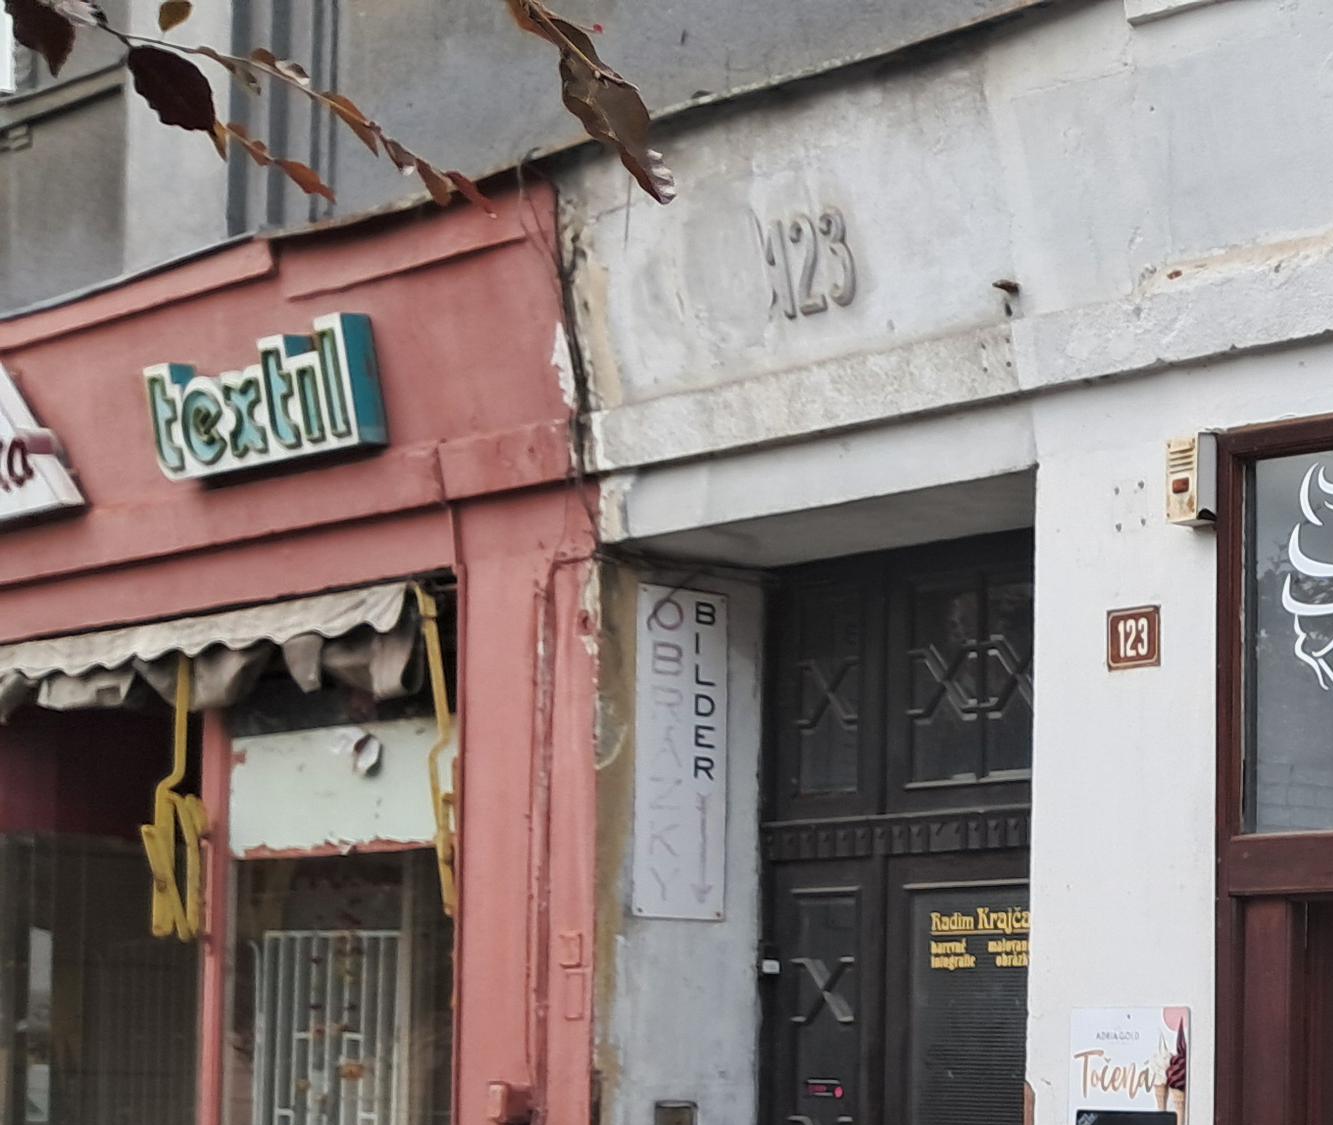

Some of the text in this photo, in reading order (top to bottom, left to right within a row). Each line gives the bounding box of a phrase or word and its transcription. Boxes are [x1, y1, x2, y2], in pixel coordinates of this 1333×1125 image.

[147, 324, 353, 474] textil
[1117, 616, 1149, 658] 123
[693, 601, 717, 781] BILDER
[1073, 1049, 1156, 1100] Točená
